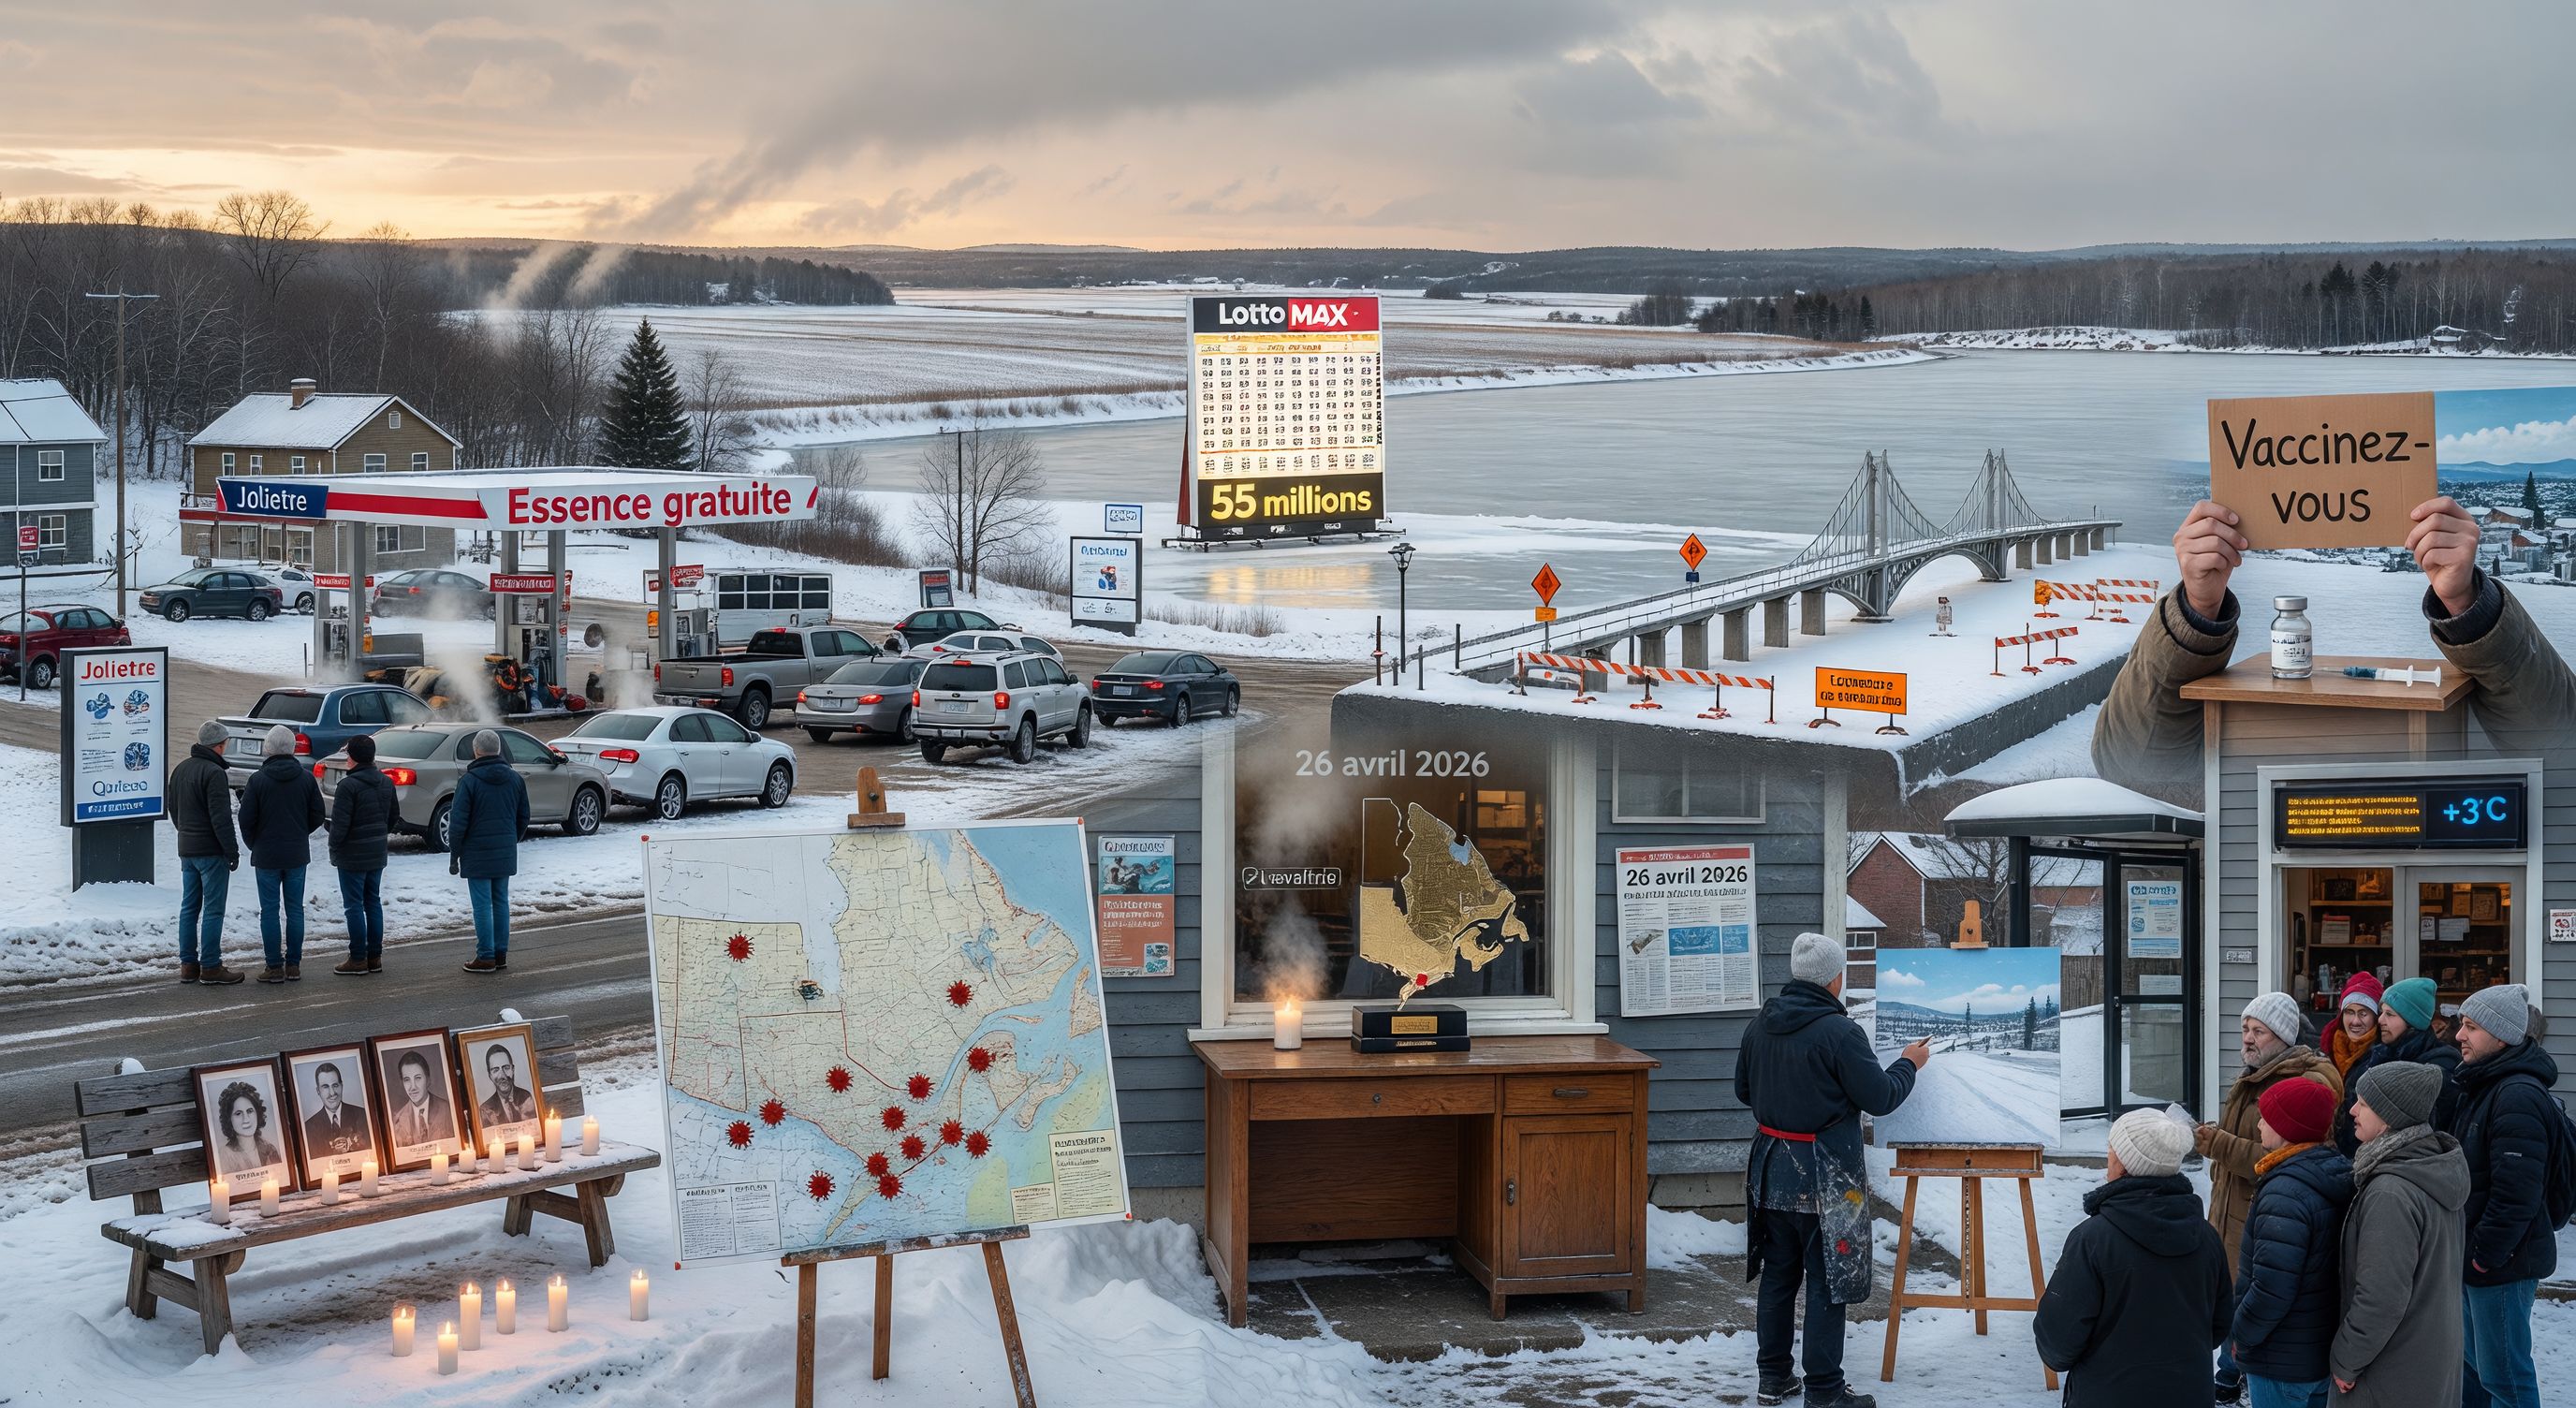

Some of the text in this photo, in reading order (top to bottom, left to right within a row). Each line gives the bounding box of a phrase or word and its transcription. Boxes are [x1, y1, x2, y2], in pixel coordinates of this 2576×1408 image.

[1219, 302, 1349, 327] Lotto MAX
[2220, 418, 2430, 470] Vaccinez-
[508, 481, 792, 527] Essence gratuite
[1211, 483, 1372, 521] 55 millions
[2271, 489, 2371, 524] vous
[1295, 749, 1490, 777] 26 avril 2026
[1626, 865, 1749, 887] 26 avril 2026
